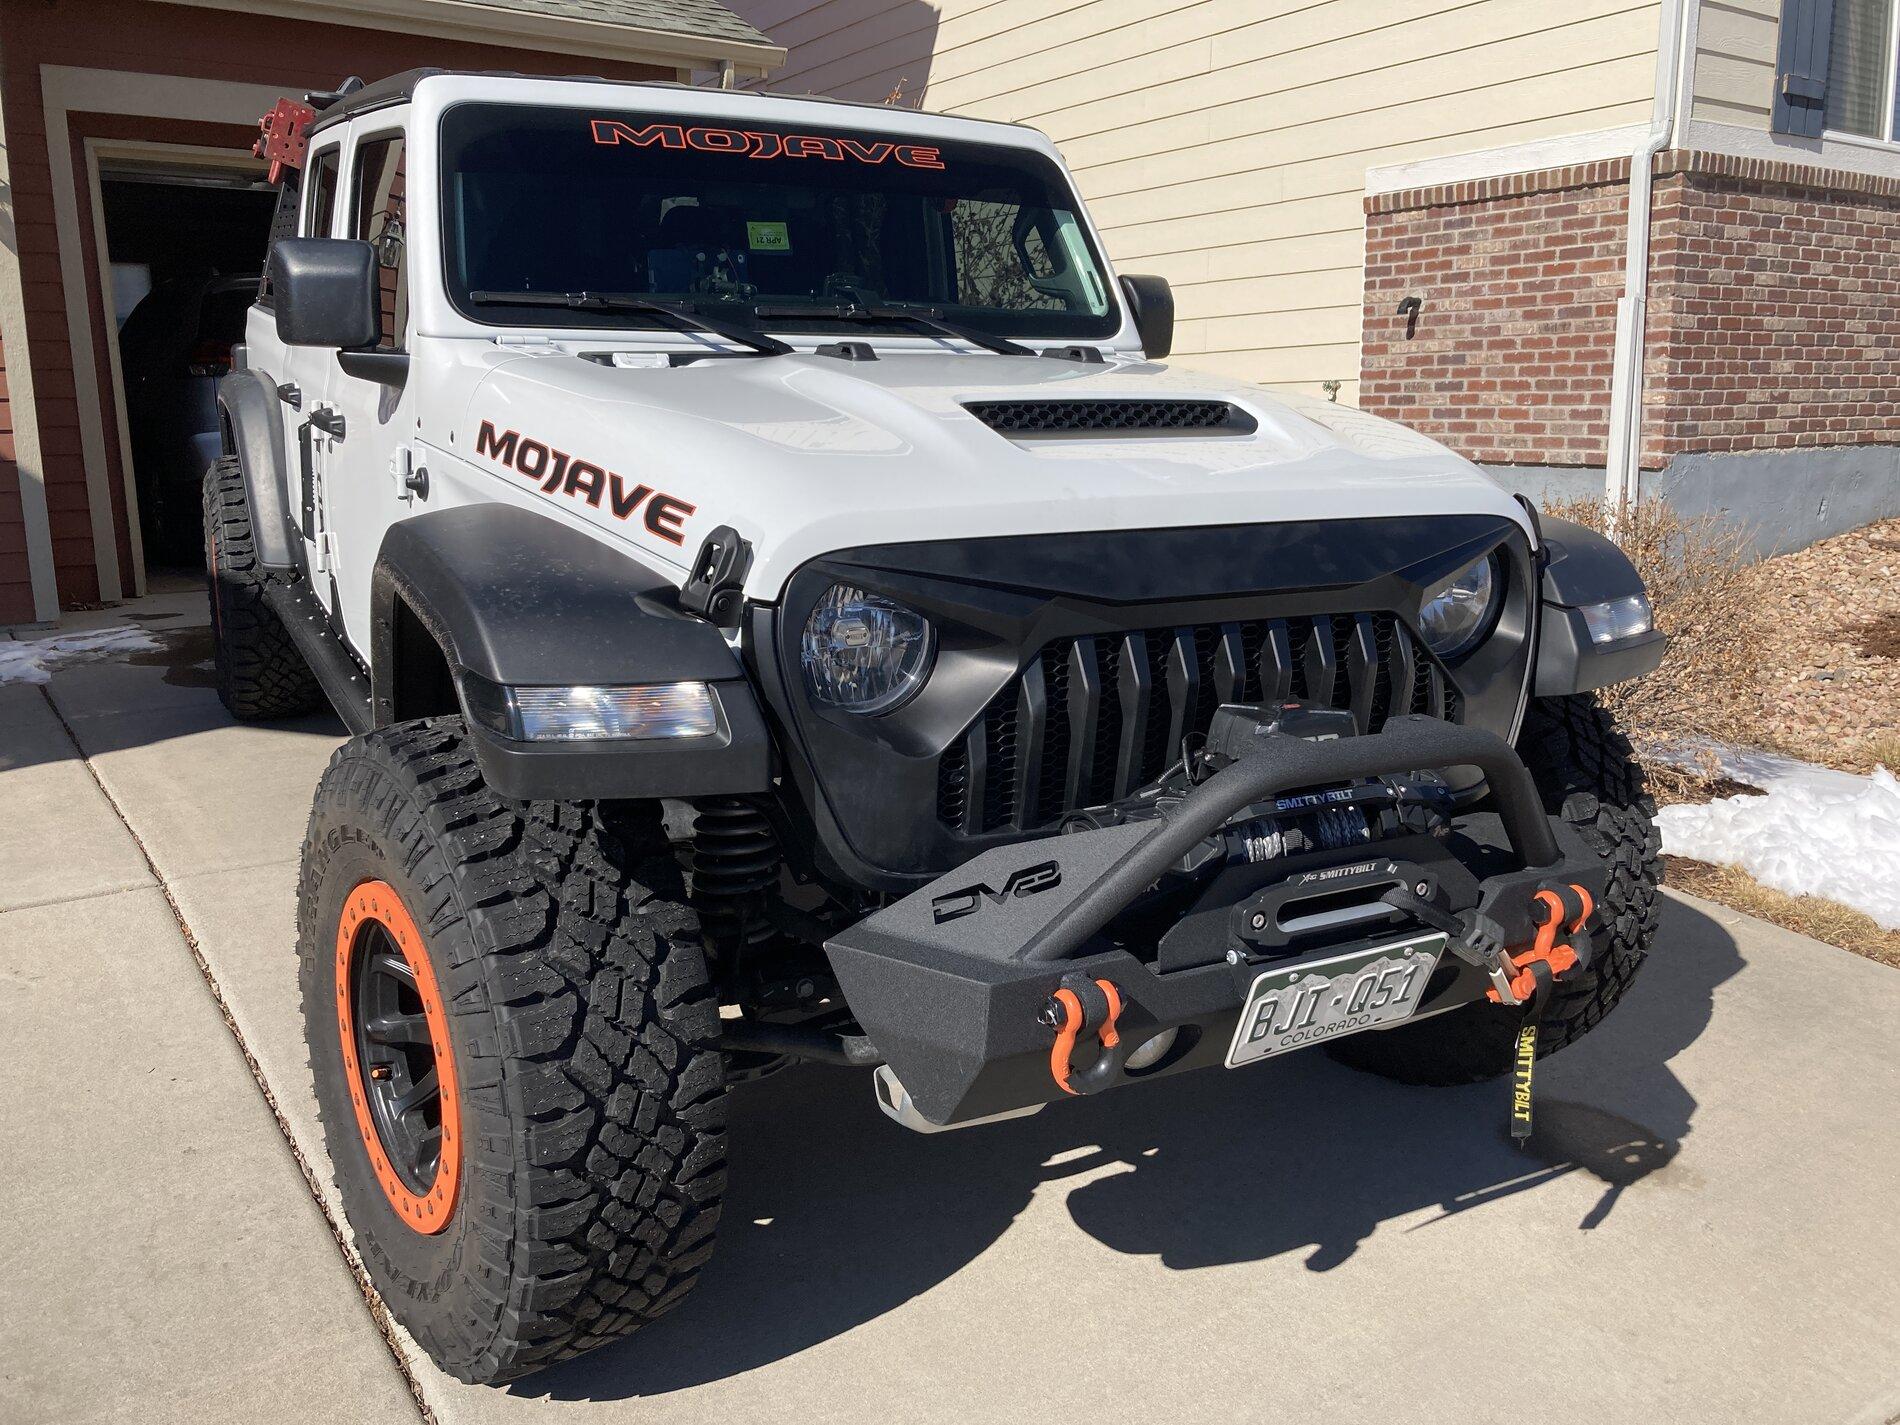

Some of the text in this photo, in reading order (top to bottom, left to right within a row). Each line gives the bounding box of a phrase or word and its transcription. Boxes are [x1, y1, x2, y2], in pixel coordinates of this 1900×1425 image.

[590, 119, 946, 170] MOJAVE
[475, 419, 698, 547] MOJAVE
[1276, 789, 1353, 810] SMITTYBILT
[1319, 862, 1377, 881] SMITTYBILT
[1280, 1013, 1371, 1047] COLORADO
[1513, 1025, 1537, 1122] SMITTYBILT
